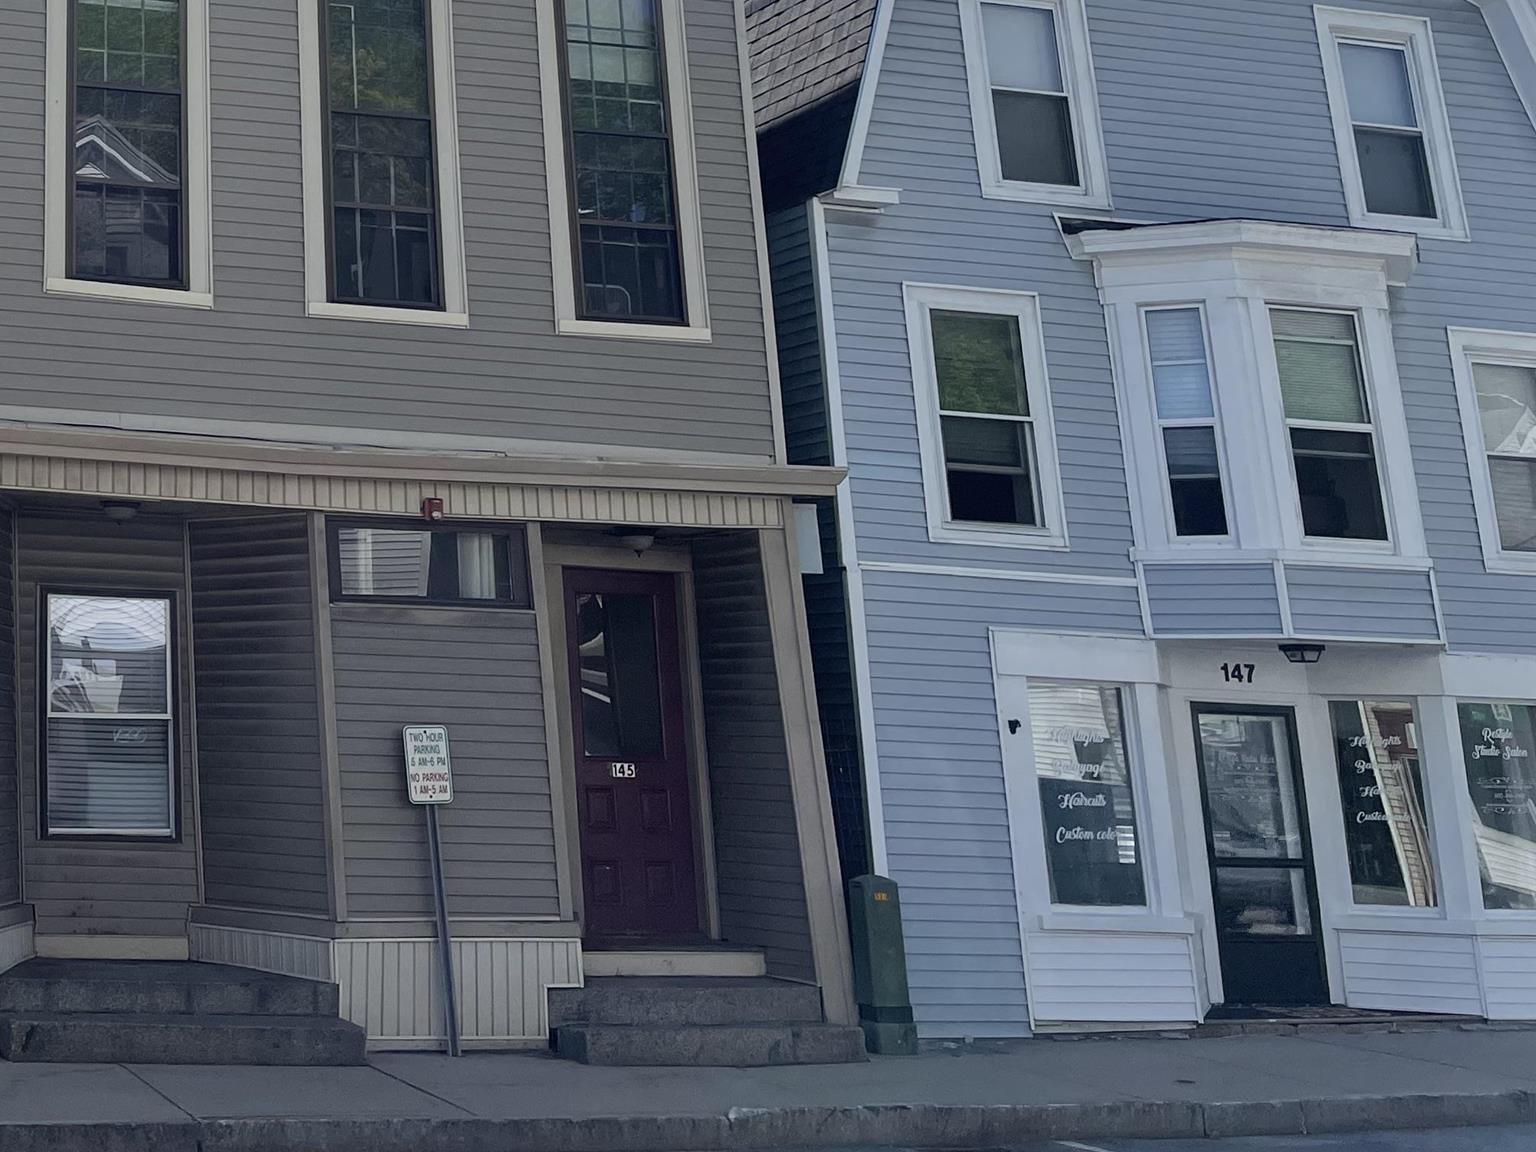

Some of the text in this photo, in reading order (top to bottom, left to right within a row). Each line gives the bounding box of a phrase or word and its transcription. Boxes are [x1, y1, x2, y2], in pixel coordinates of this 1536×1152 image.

[1220, 662, 1255, 683] 147
[409, 732, 444, 743] TWO HOUR
[413, 744, 440, 755] PARKING
[1472, 744, 1528, 761] Studio Salon
[437, 757, 446, 766] PM
[613, 764, 634, 777] 145
[410, 772, 449, 783] NO PARKING
[414, 785, 449, 795] 1 AM-5 AM
[1058, 791, 1107, 809] Haircuts
[1056, 826, 1094, 844] Custom
